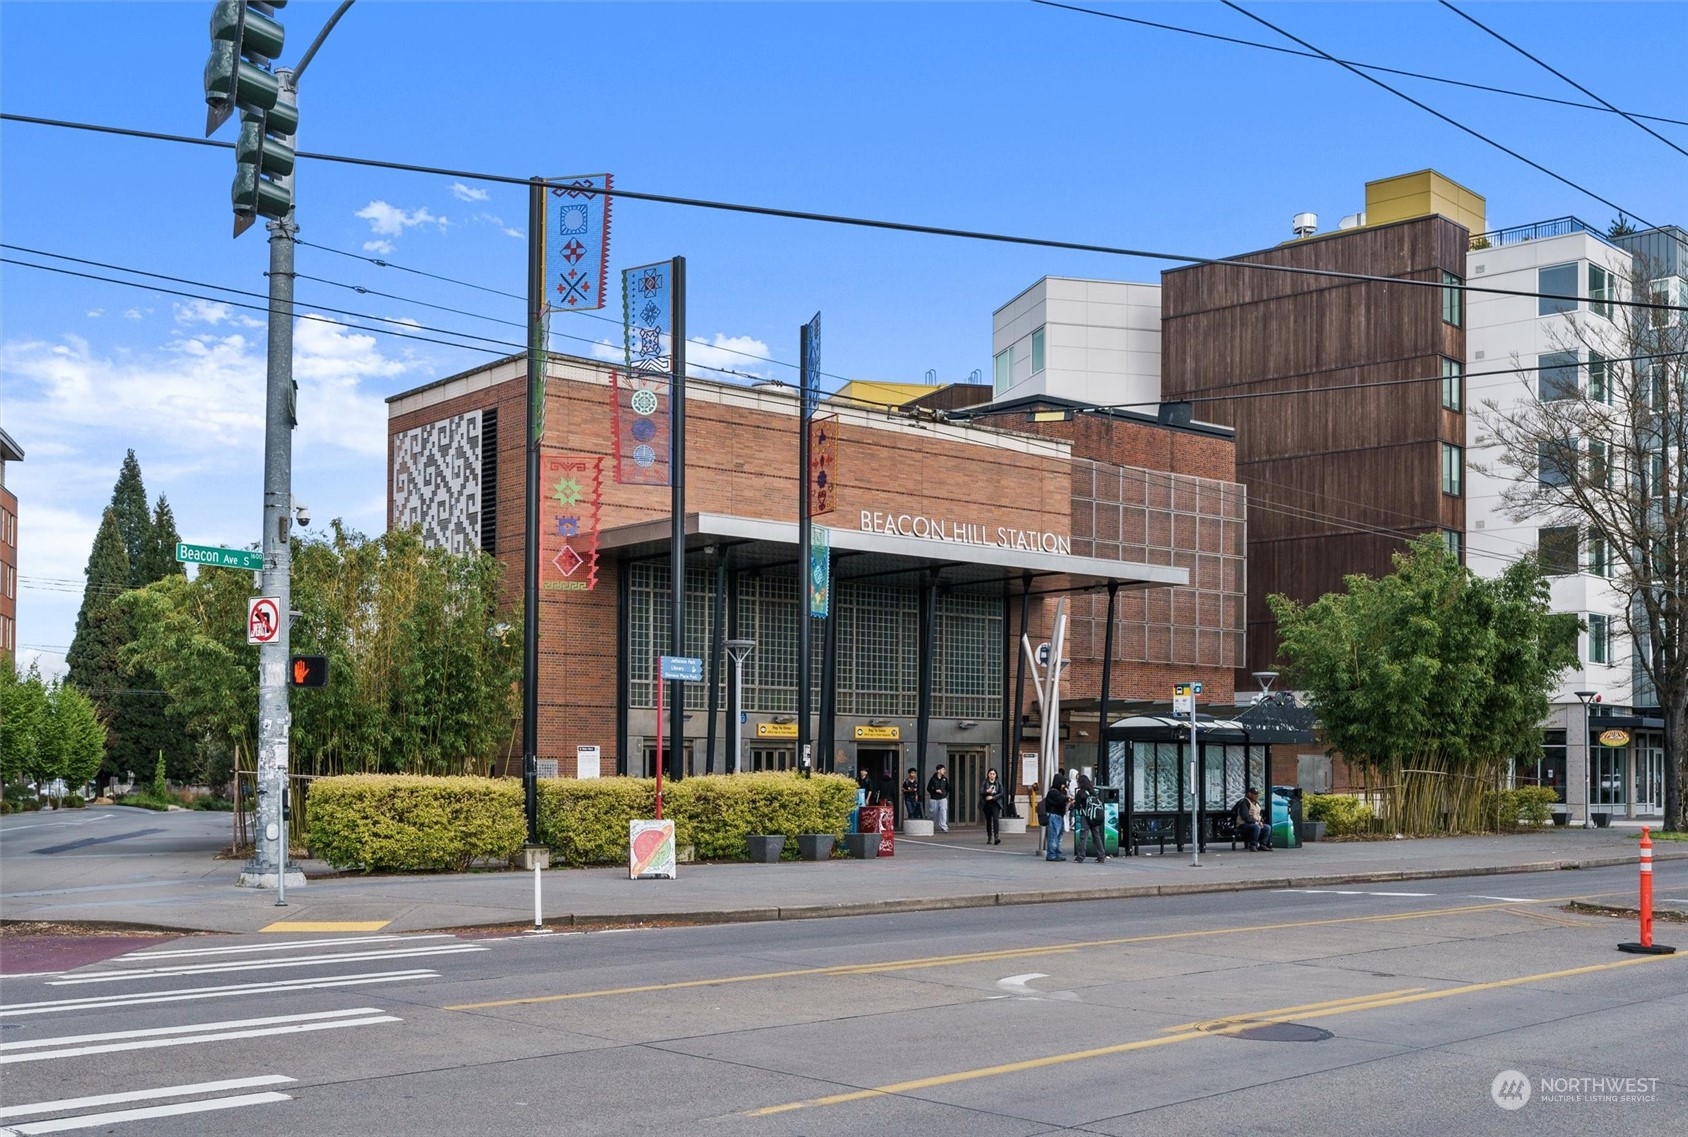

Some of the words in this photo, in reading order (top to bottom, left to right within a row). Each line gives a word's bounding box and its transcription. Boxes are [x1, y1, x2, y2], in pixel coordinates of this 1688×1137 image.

[860, 510, 946, 540] BEACON
[952, 521, 990, 546] HILL
[997, 527, 1071, 555] STATION
[180, 545, 219, 563] Beacon
[223, 555, 238, 565] Ave
[243, 557, 250, 566] S
[250, 552, 262, 561] 1600
